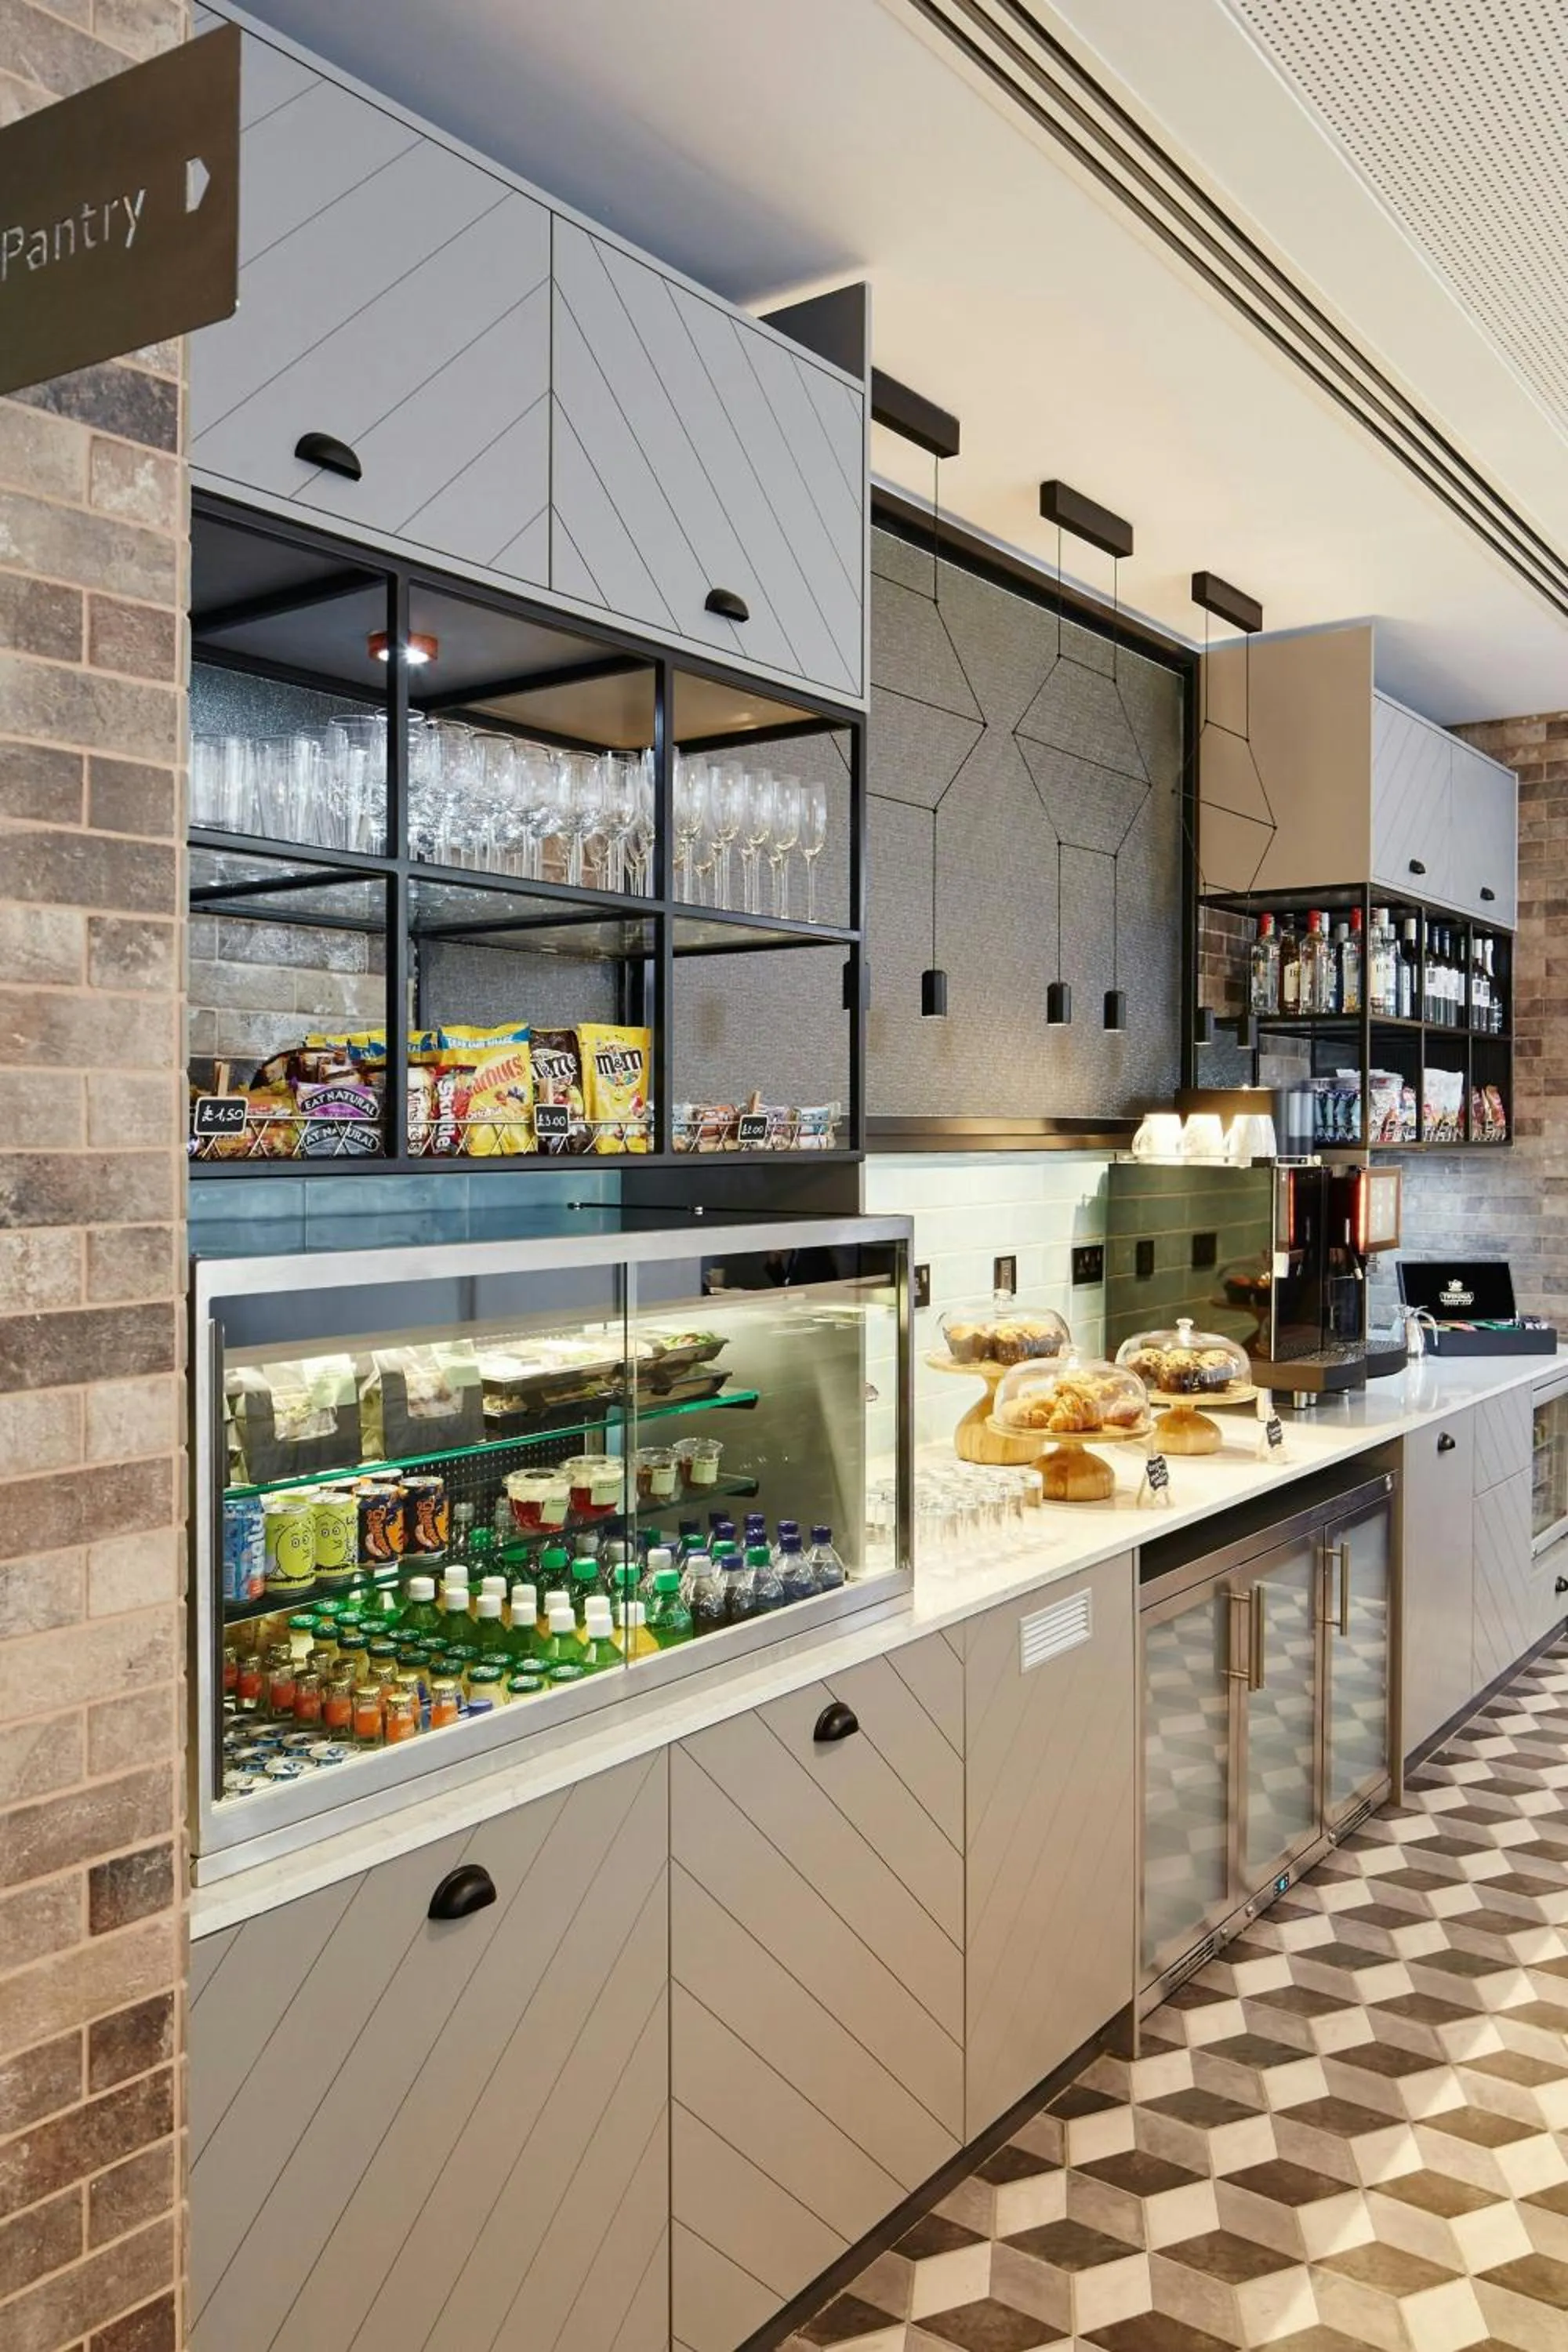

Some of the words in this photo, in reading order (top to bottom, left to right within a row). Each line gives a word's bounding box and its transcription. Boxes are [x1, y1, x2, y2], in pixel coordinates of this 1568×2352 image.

[2, 189, 147, 281] Pantry
[304, 1094, 325, 1109] EAT
[327, 1090, 376, 1116] NATURAL
